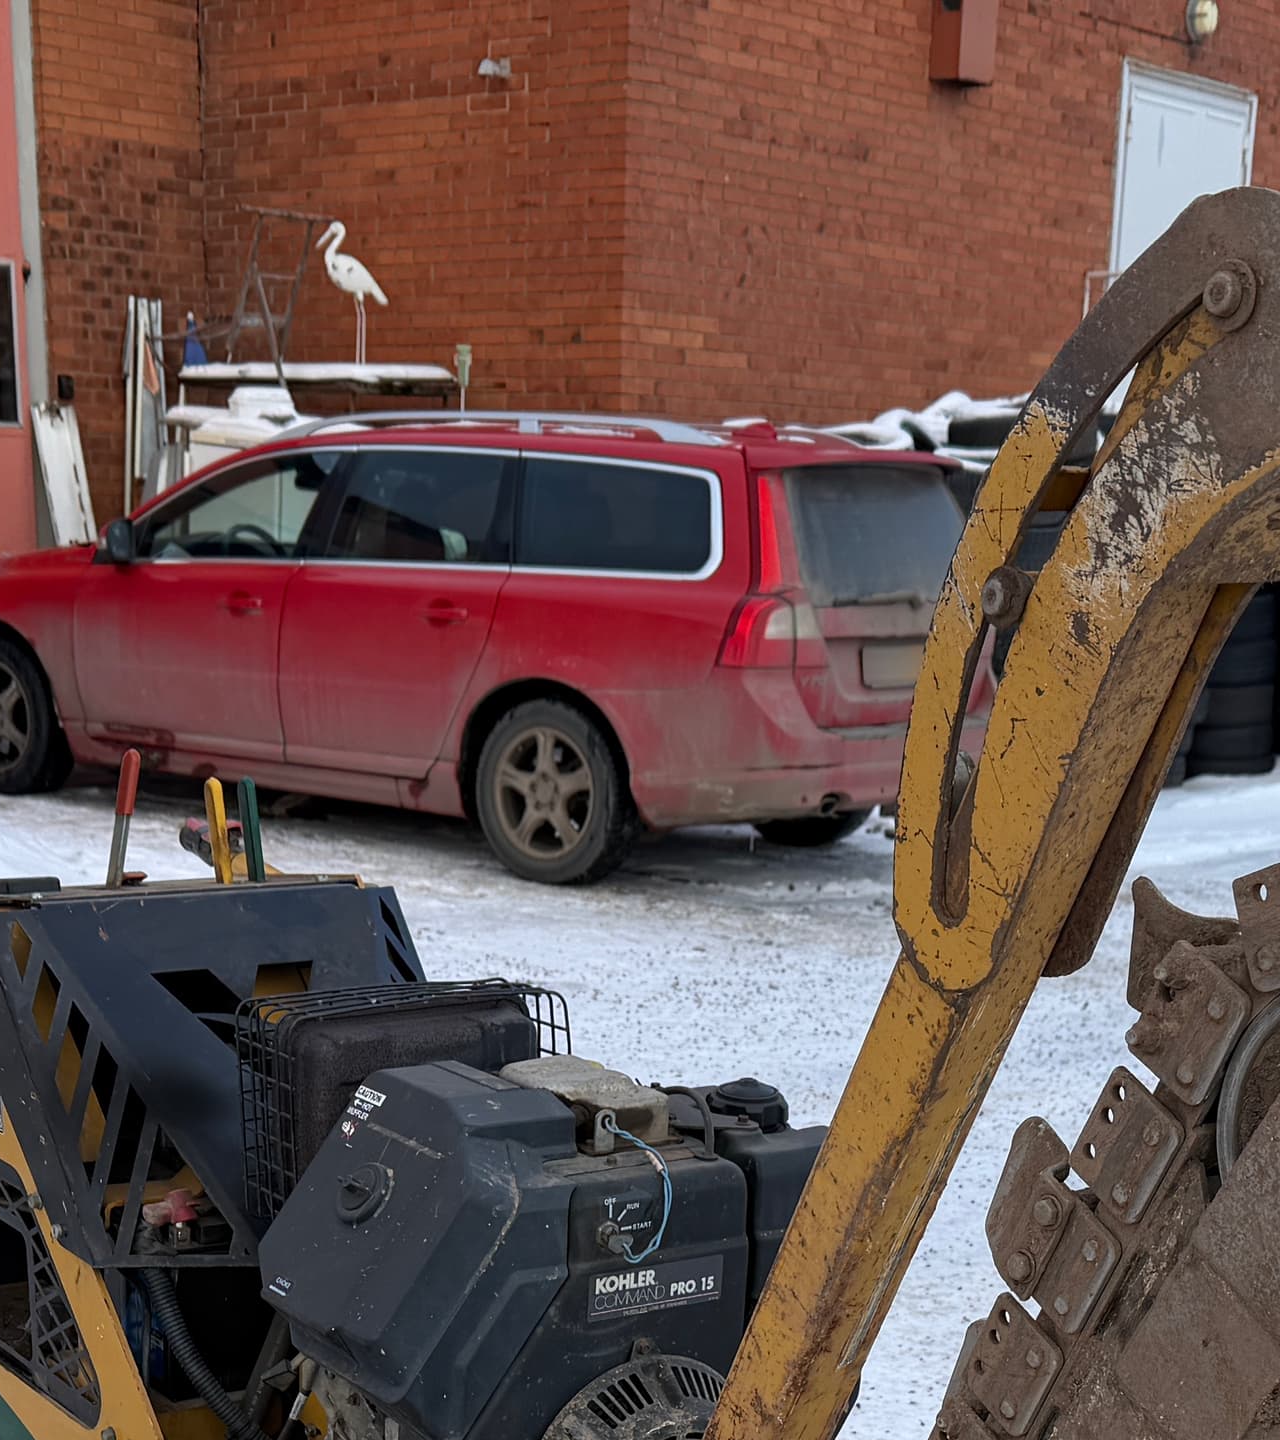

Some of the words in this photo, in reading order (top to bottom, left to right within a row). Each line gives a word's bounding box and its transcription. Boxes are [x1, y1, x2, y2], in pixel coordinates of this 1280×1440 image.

[632, 1220, 652, 1230] START
[594, 1285, 666, 1310] COMMAND
[669, 1279, 697, 1297] PRO
[701, 1275, 715, 1291] 15
[595, 1269, 656, 1295] KOHLER
